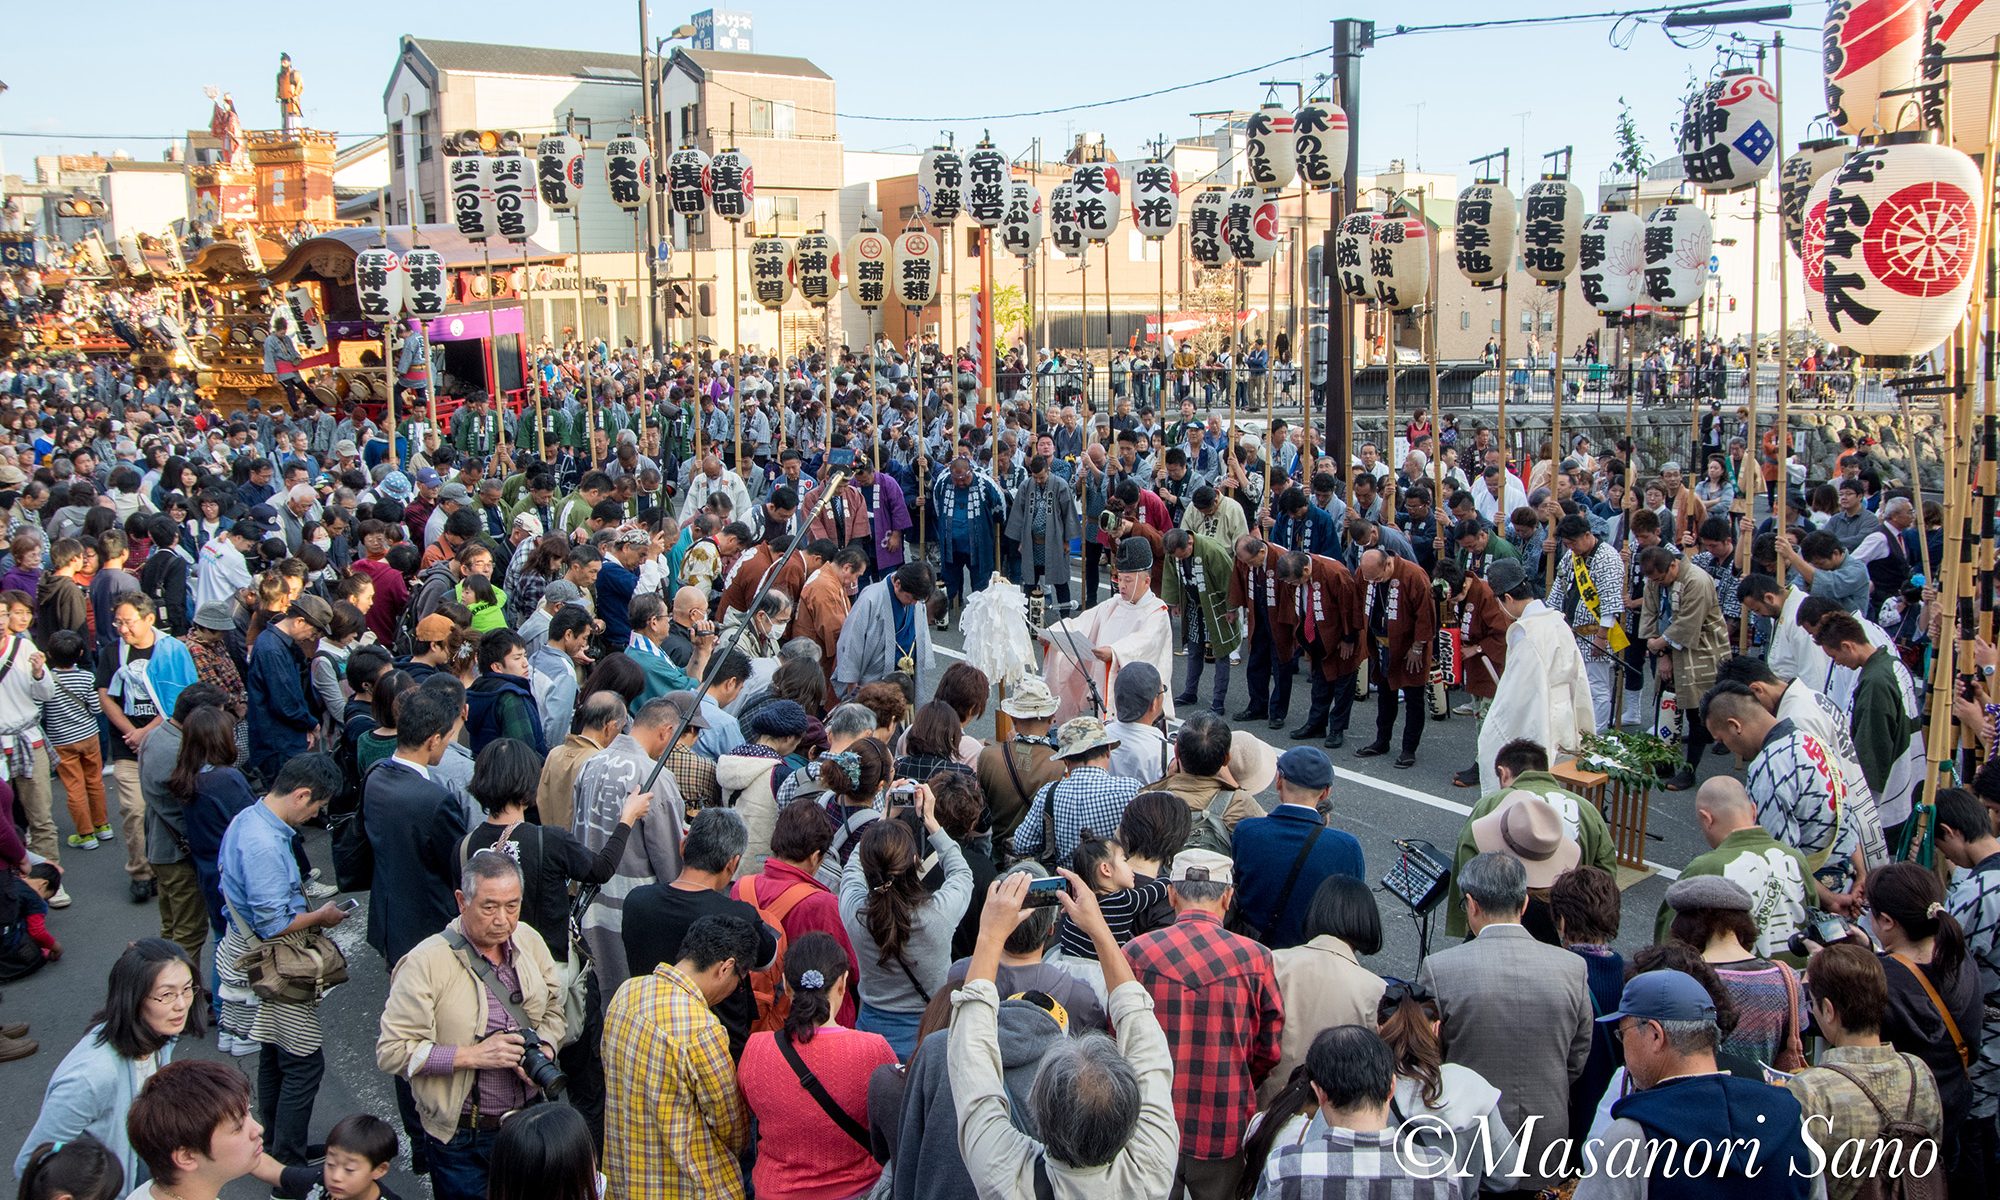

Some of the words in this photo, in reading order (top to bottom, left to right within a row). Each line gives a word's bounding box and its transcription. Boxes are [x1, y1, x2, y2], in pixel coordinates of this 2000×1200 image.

[1295, 107, 1331, 182] 木の花
[539, 156, 568, 204] 大和
[609, 157, 640, 202] 大和
[670, 164, 701, 212] 浅間
[711, 166, 744, 214] 浅間
[932, 153, 963, 220] 常磐
[968, 152, 1005, 220] 常磐
[1074, 167, 1106, 230] 咲花
[1137, 167, 1172, 227] 咲花
[1456, 201, 1492, 272] 阿幸地
[1525, 197, 1567, 272] 阿幸地
[358, 267, 389, 316] 神立
[411, 267, 442, 315] 神立
[754, 257, 784, 302] 神賀
[799, 251, 829, 299] 神賀
[858, 261, 885, 301] 瑞穂
[903, 260, 931, 301] 瑞穂
[1370, 247, 1399, 306] 城山
